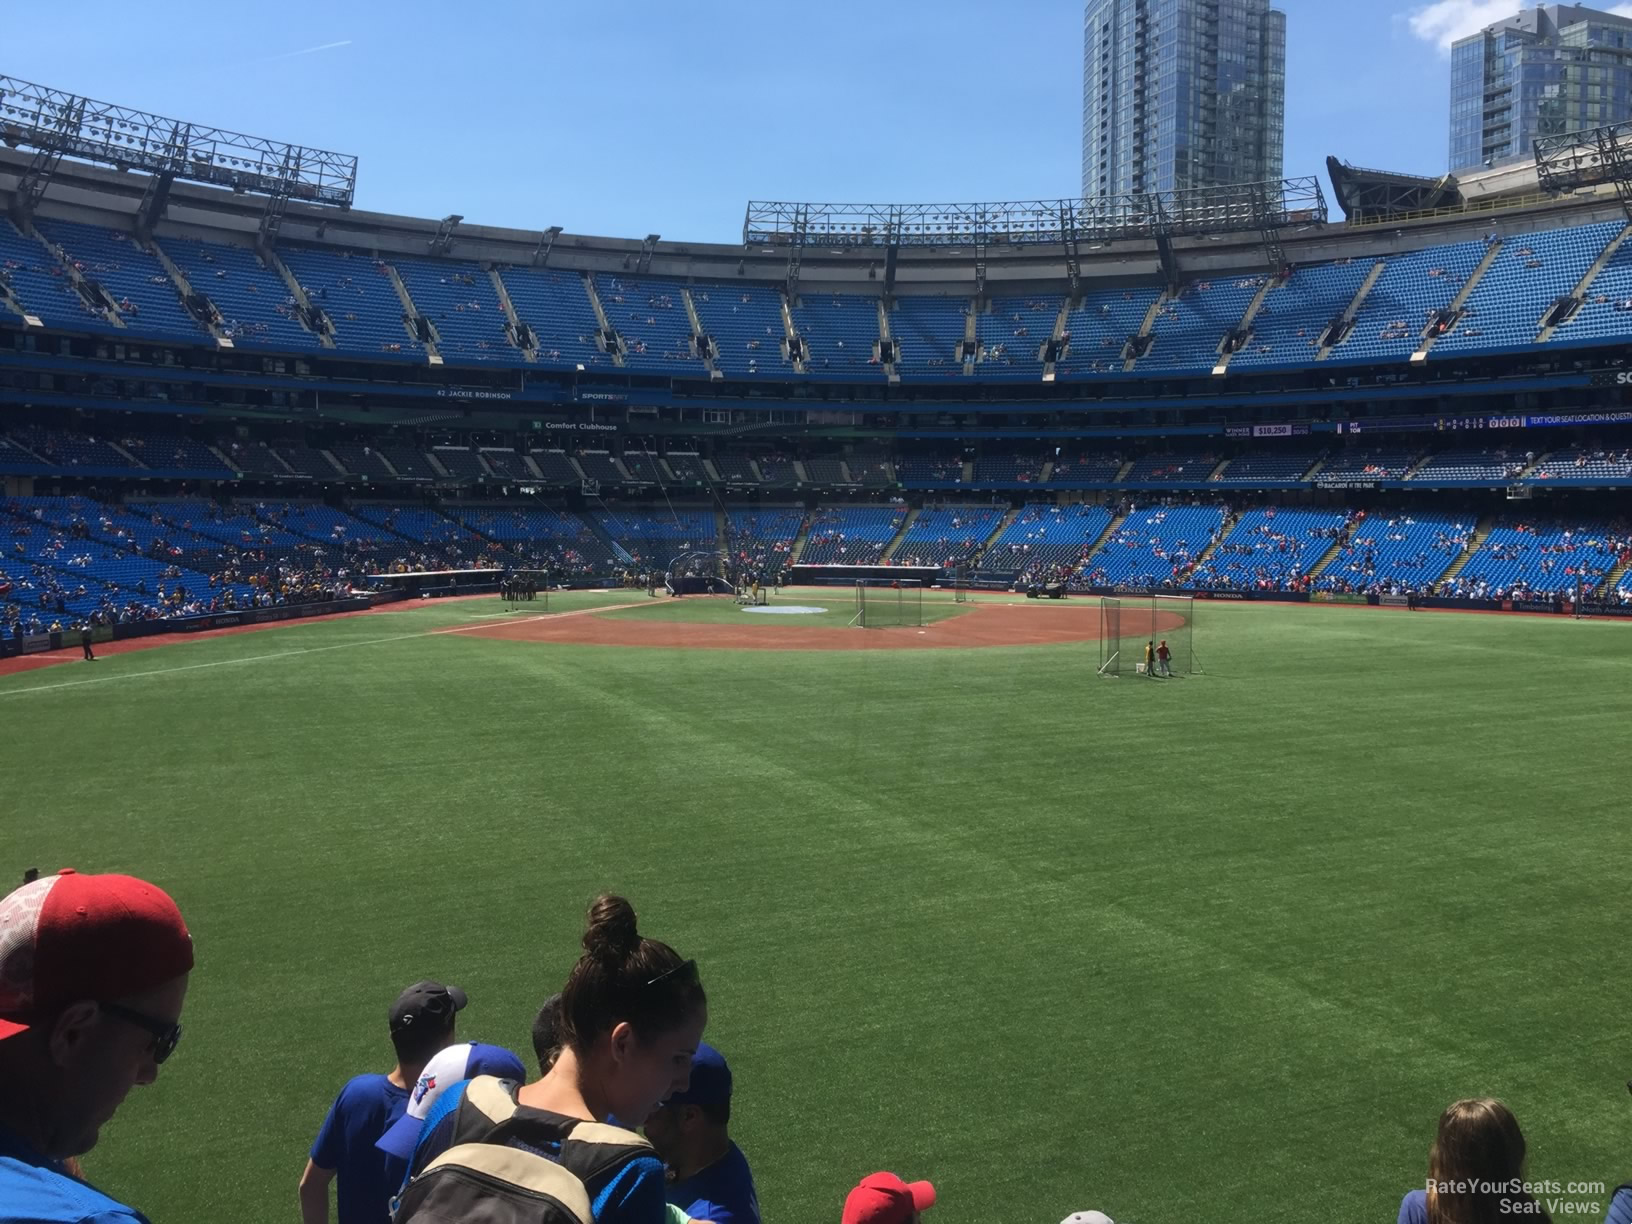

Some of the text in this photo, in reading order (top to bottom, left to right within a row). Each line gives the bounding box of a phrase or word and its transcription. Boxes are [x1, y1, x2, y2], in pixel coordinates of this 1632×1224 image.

[1530, 416, 1543, 425] TEXT
[1561, 415, 1574, 423] SEAT
[1574, 413, 1605, 422] LOCATION
